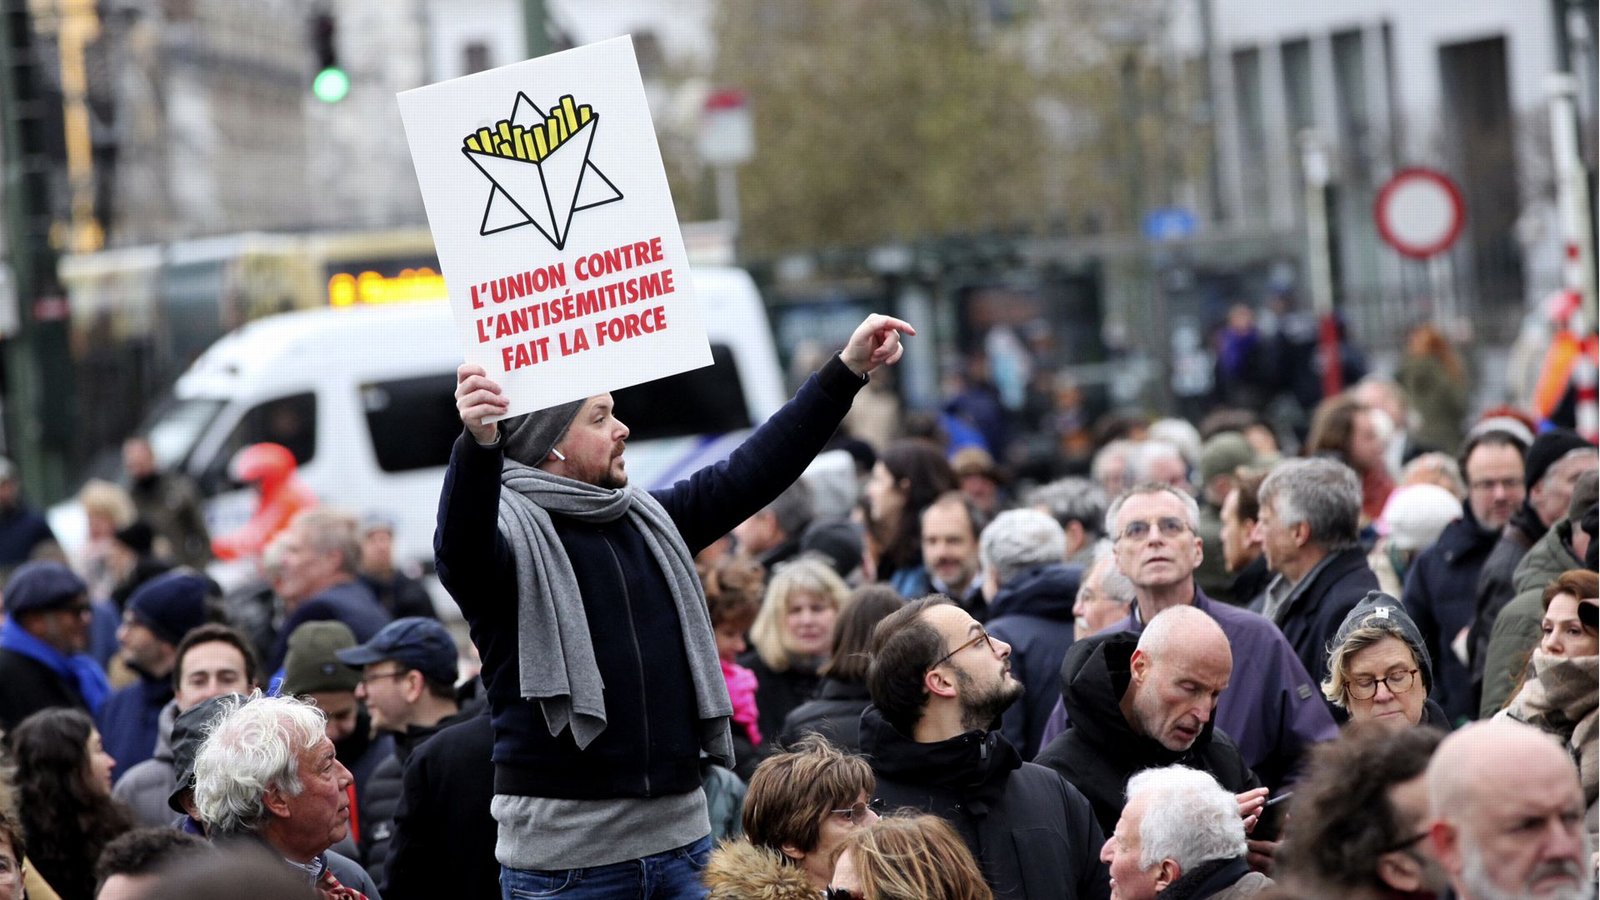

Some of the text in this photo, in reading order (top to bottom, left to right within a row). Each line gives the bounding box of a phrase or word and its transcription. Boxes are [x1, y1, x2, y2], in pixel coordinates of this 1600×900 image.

[470, 262, 567, 310] L'UNION
[573, 236, 664, 281] CONTRE
[476, 269, 675, 344] L'ANTISÉMITISME
[501, 306, 667, 372] FAIT LA FORCE
